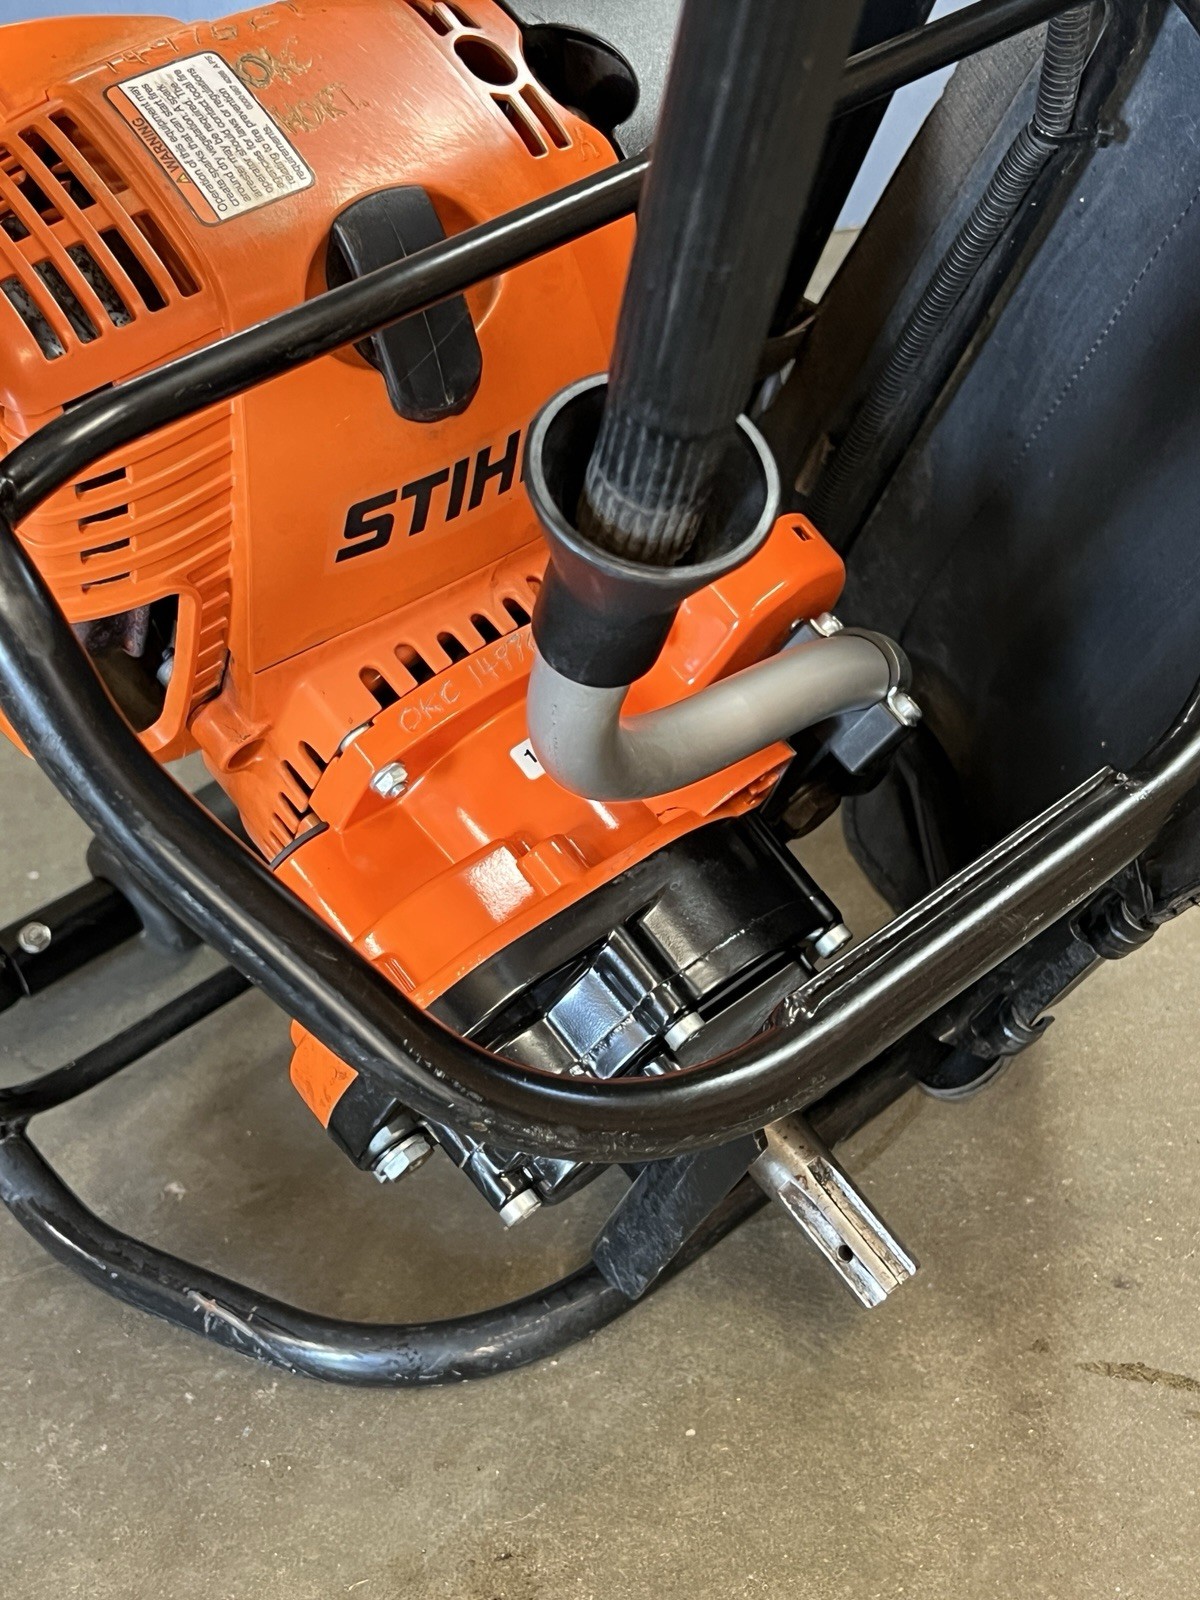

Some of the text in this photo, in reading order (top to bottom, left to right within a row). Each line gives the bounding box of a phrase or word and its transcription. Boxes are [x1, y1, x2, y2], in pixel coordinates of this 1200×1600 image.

[156, 83, 177, 104] spark
[127, 85, 227, 211] Operation of this equipment may
[132, 116, 178, 172] WARNING
[141, 83, 239, 206] create sparks that can start fires
[170, 82, 262, 197] arrester may be required. The
[173, 69, 273, 193] operator should contact local fire
[181, 112, 216, 155] vegetation.
[186, 67, 284, 188] agencies for laws or regulations
[218, 87, 295, 184] relating to fire prevention
[263, 124, 305, 179] requirements.
[214, 157, 228, 170] dry
[223, 171, 251, 201] around
[335, 430, 525, 563] STIH
[399, 680, 461, 732] OKC
[524, 749, 538, 763] 1
